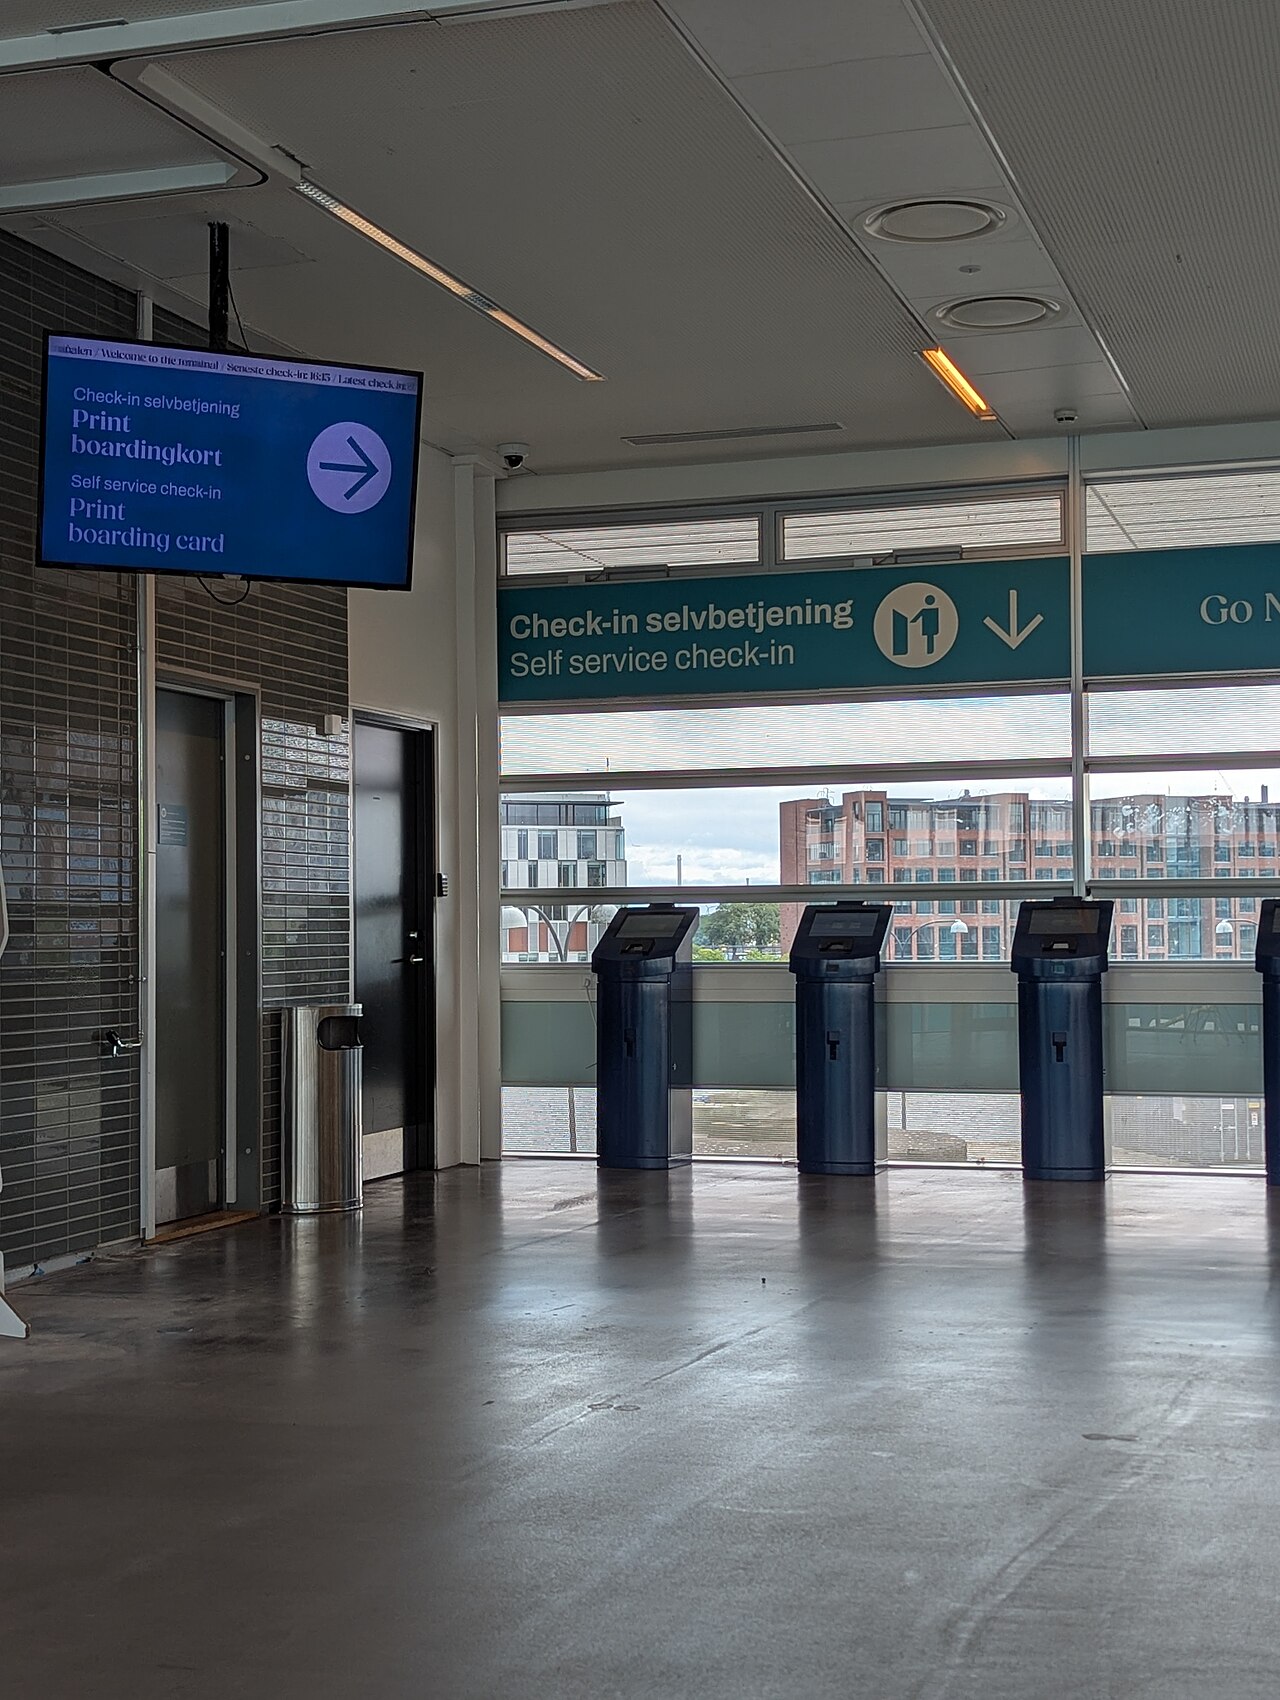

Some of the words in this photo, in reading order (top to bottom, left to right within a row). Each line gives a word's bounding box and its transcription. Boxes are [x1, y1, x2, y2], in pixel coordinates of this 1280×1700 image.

[102, 348, 147, 362] Welcome
[149, 354, 158, 364] to
[161, 355, 177, 366] the
[226, 363, 264, 375] Seneste
[338, 374, 366, 387] Latest
[73, 387, 140, 406] Check-in
[143, 395, 241, 418] selvbetjening
[72, 408, 132, 433] Print
[71, 433, 223, 467] boardingkort
[71, 474, 101, 489] Self
[103, 478, 157, 494] service
[160, 482, 222, 500] check-in
[69, 497, 126, 521] Print
[68, 522, 170, 553] boarding
[175, 533, 225, 553] card
[509, 608, 639, 640] Check-in
[645, 598, 854, 634] selvbetjening
[1200, 594, 1254, 625] Go
[509, 649, 563, 677] Self
[568, 645, 668, 674] service
[674, 638, 795, 670] check-in
